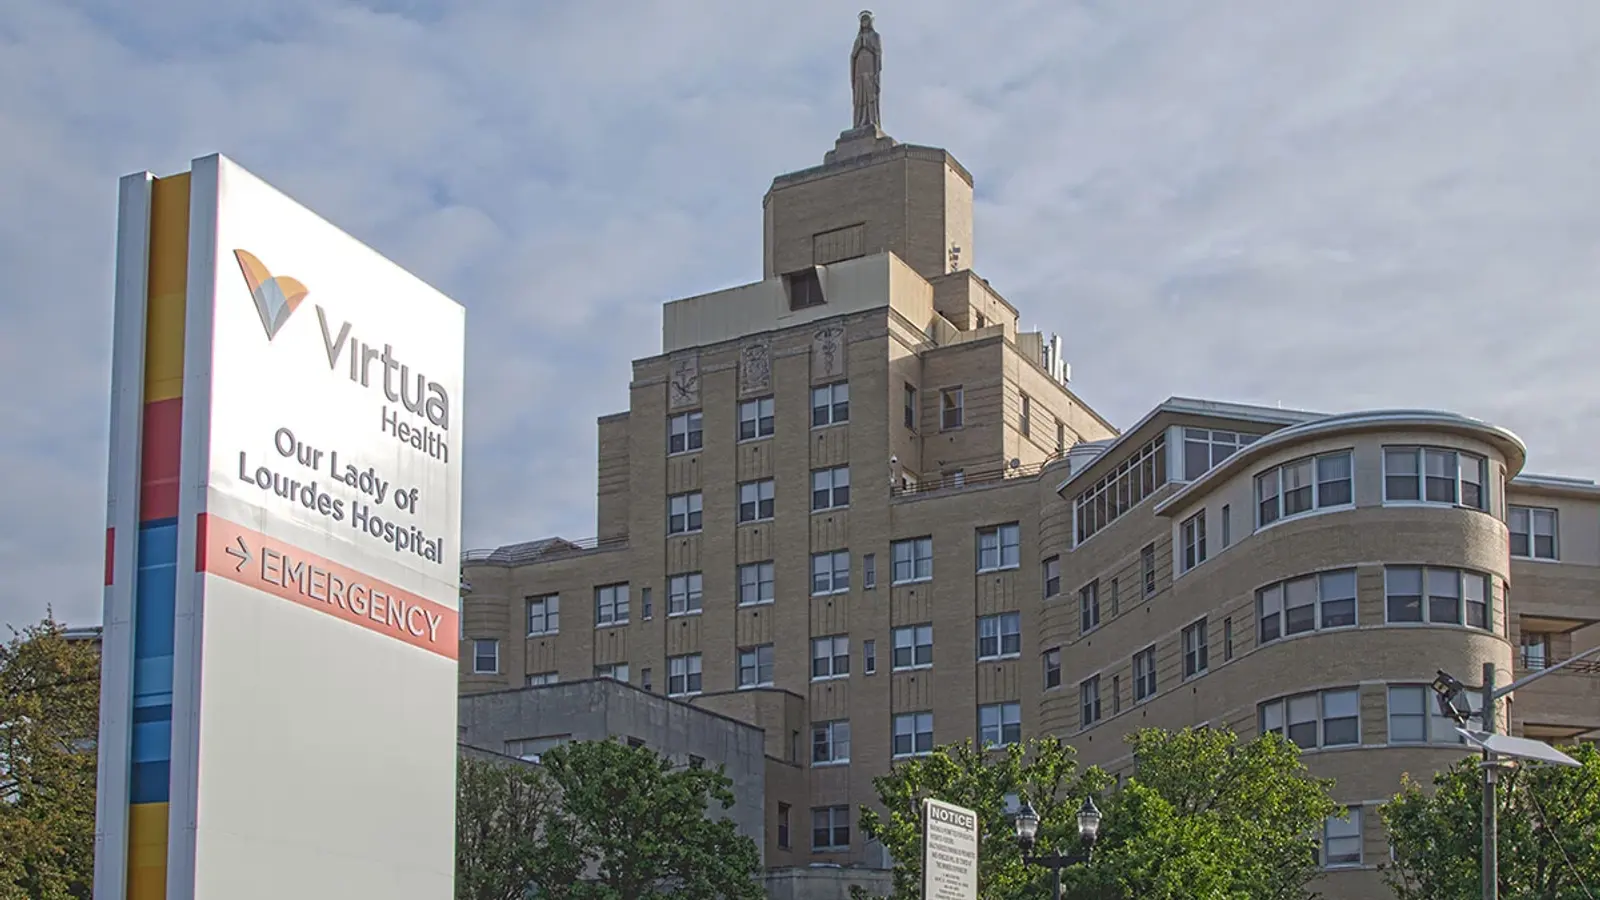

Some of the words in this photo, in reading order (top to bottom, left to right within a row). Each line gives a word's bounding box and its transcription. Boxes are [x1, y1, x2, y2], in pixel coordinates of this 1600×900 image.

[315, 304, 450, 430] Virtua
[274, 426, 323, 469] Our
[331, 451, 388, 506] Lady
[395, 488, 419, 515] of
[381, 406, 449, 464] Health
[238, 451, 344, 522] Lourdes
[352, 501, 444, 565] Hospital
[260, 546, 443, 642] EMERGENCY
[931, 806, 973, 828] NOTICE
